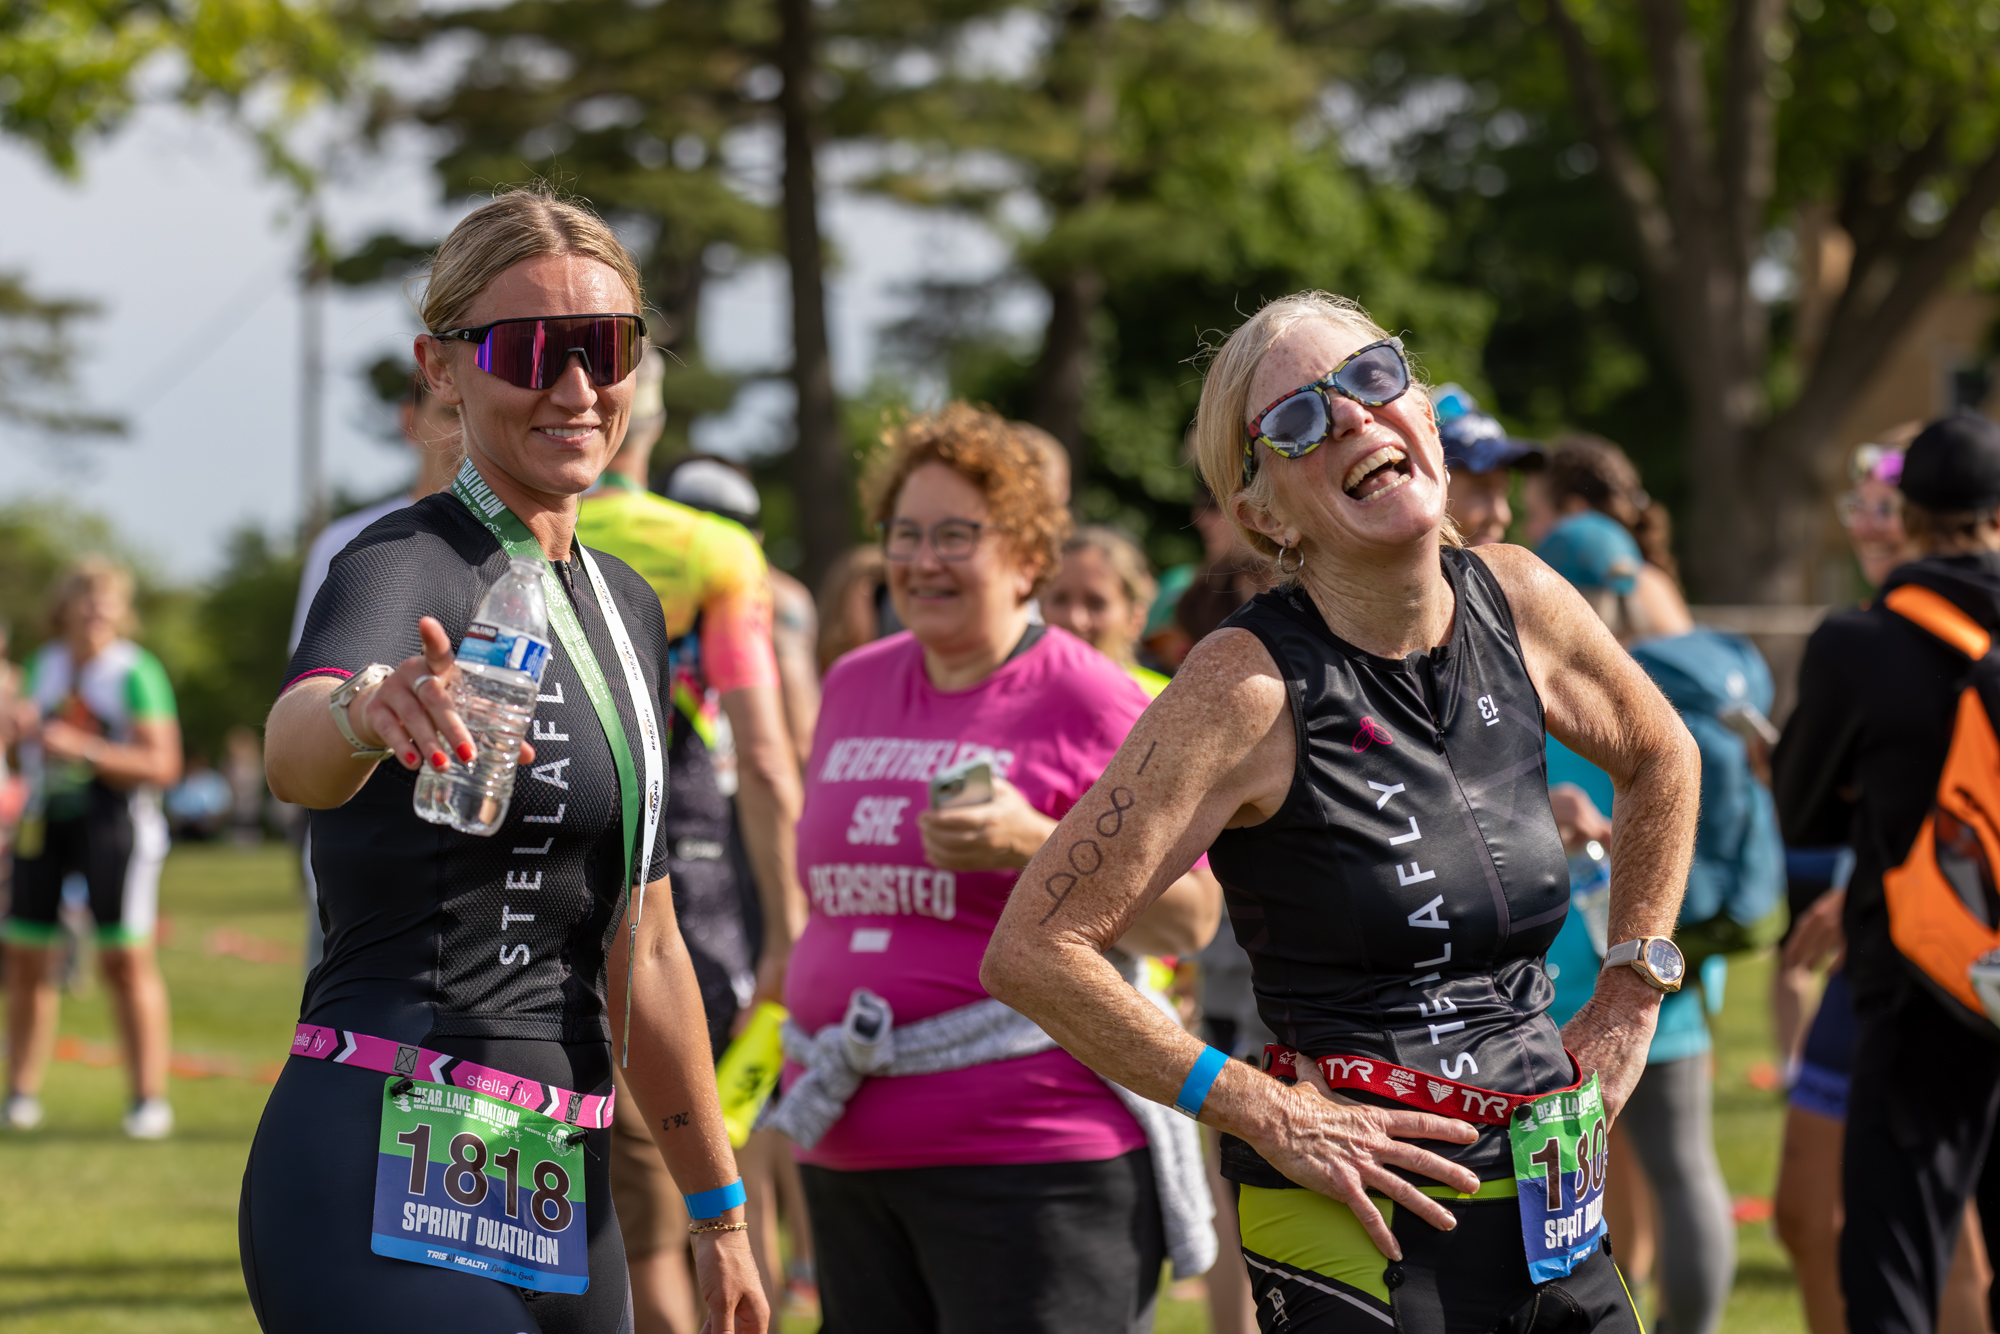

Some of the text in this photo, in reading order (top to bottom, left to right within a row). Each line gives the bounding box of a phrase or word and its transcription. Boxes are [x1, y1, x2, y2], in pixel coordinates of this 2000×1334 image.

[500, 653, 570, 965] STELLAFL
[847, 795, 911, 846] SHE
[808, 863, 957, 922] PERSISTED
[1326, 1057, 1374, 1083] TYR
[1391, 1068, 1416, 1082] USA
[413, 1087, 520, 1128] BEAR LAKE TRIATHLON
[466, 1075, 532, 1105] stellafly
[1461, 1088, 1509, 1118] TYR
[662, 1112, 689, 1131] 26.2
[1535, 1098, 1562, 1119] BEAR
[547, 1134, 561, 1144] BEAR
[397, 1122, 574, 1233] 1818
[1530, 1116, 1607, 1212] 180
[402, 1201, 559, 1266] SPRINT DUATHLON
